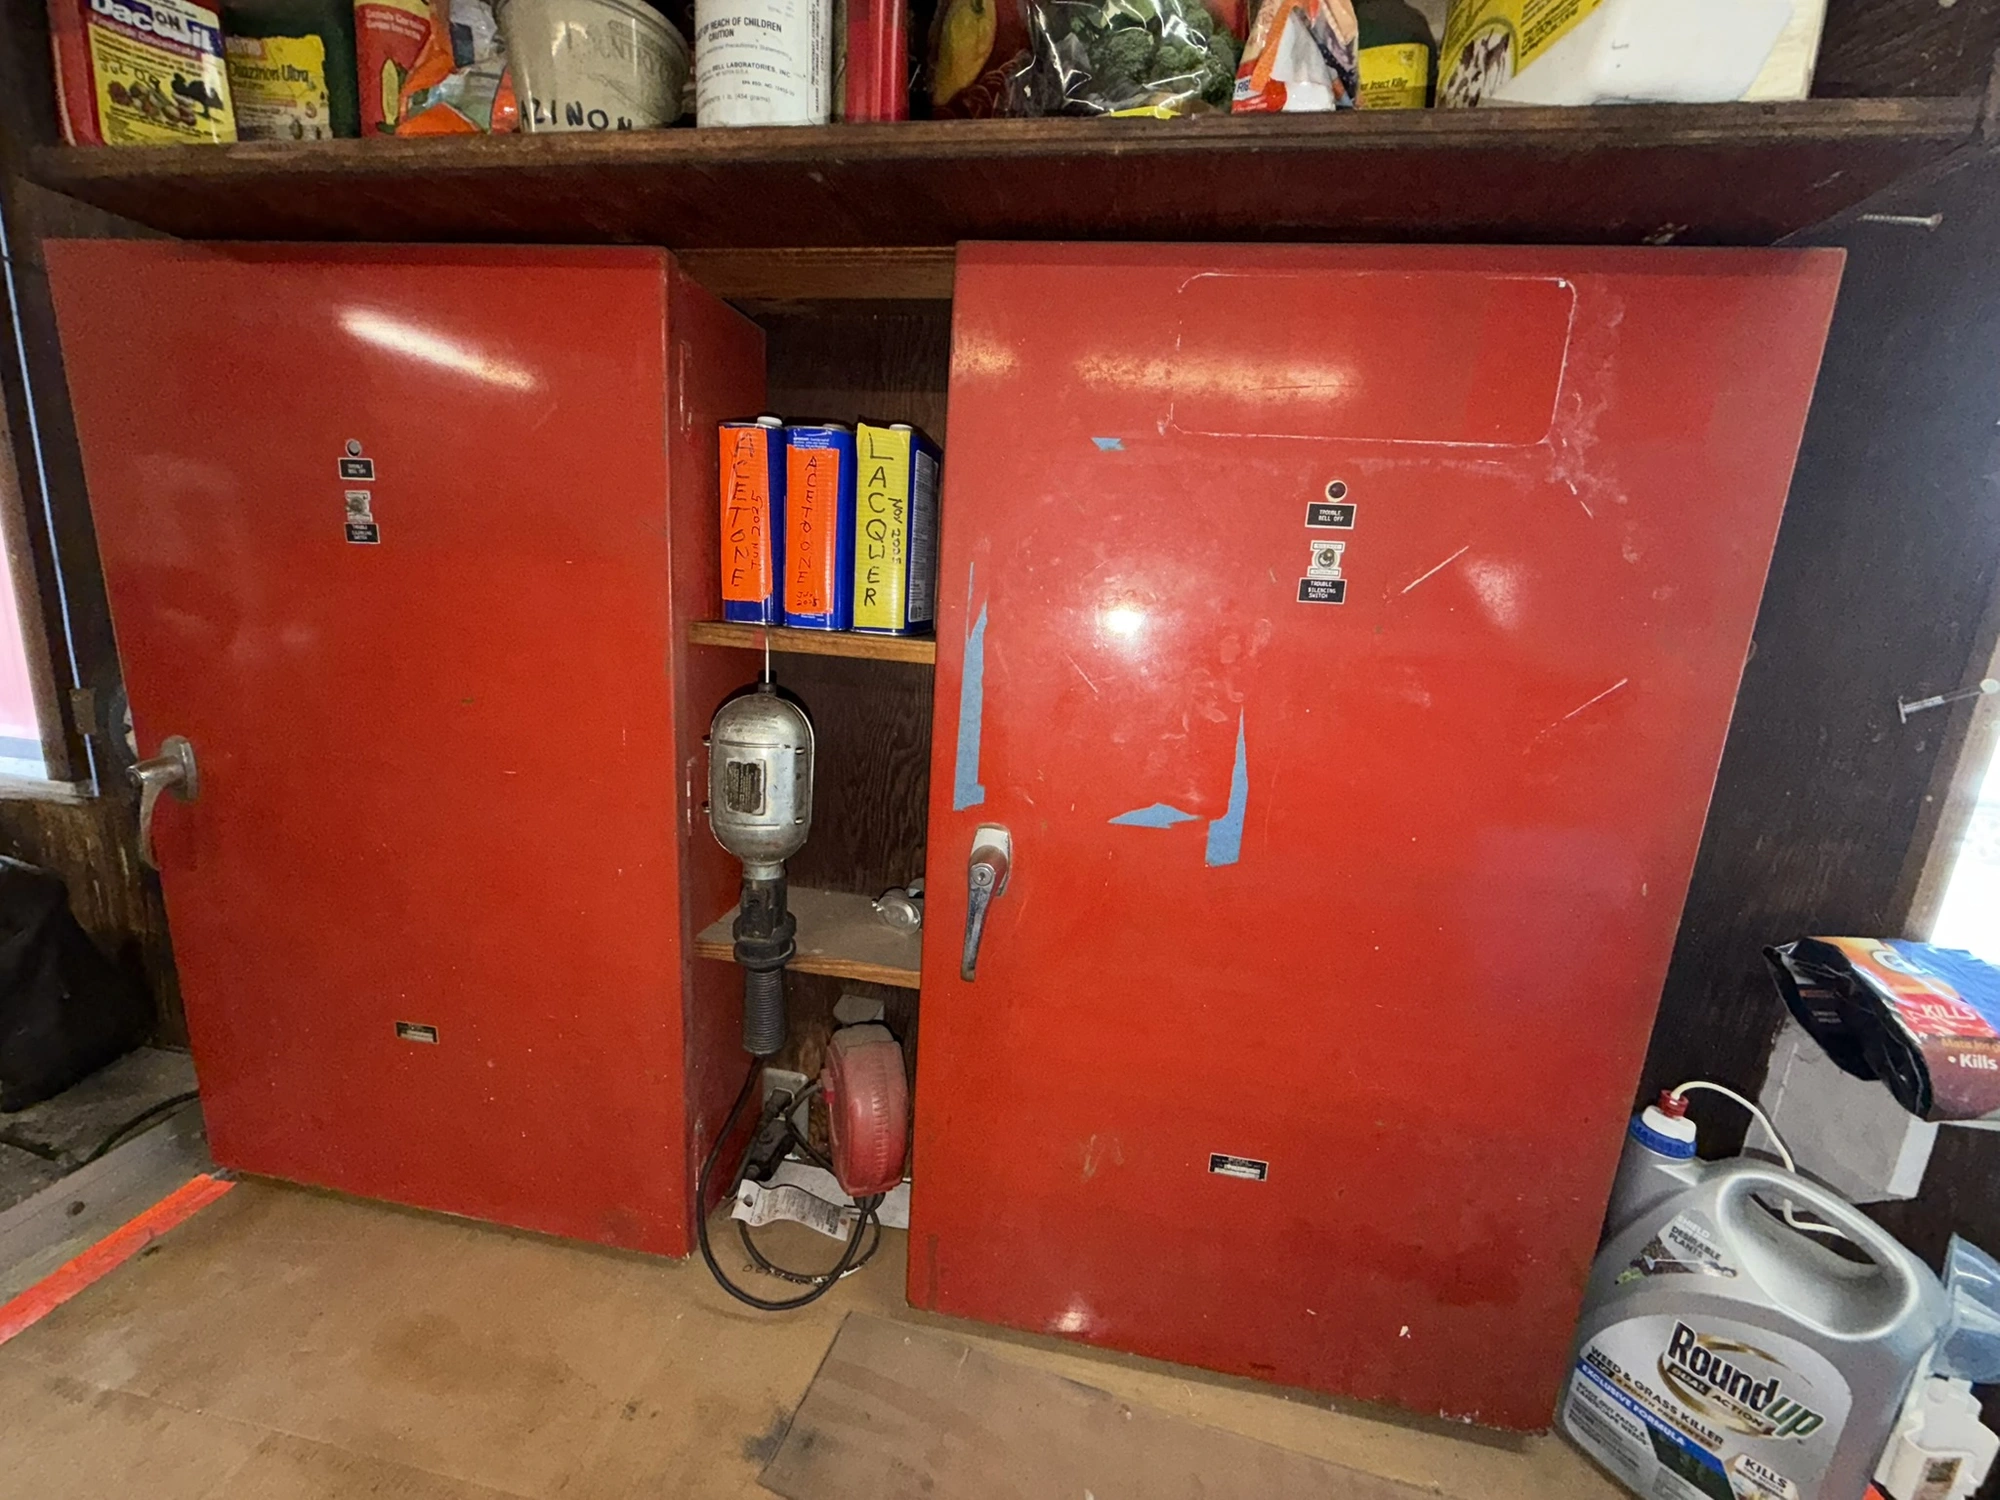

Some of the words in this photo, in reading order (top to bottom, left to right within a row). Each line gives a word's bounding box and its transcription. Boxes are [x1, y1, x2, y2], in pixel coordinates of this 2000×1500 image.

[708, 28, 735, 42] CAUTION
[732, 16, 742, 26] OF
[743, 16, 782, 33] CHILDREN
[712, 64, 725, 72] BELL
[729, 432, 755, 587] ACETONE
[864, 432, 894, 607] LACQUER
[1921, 1004, 1977, 1020] KILLS
[1960, 1053, 1998, 1071] Kills
[1668, 1232, 1704, 1259] PLANTS
[1671, 1225, 1722, 1261] DESIRABLE
[1590, 1345, 1622, 1374] WEED
[1623, 1372, 1632, 1382] &
[1634, 1379, 1679, 1415] GRASS
[1680, 1411, 1724, 1445] KILLER
[1667, 1320, 1825, 1438] Roundup
[1581, 1364, 1633, 1408] EXCLUSIVE
[1633, 1404, 1686, 1447] FORMULA
[1671, 1367, 1707, 1394] DUAL
[1711, 1394, 1764, 1428] ACTION
[1744, 1458, 1788, 1489] KILLS
